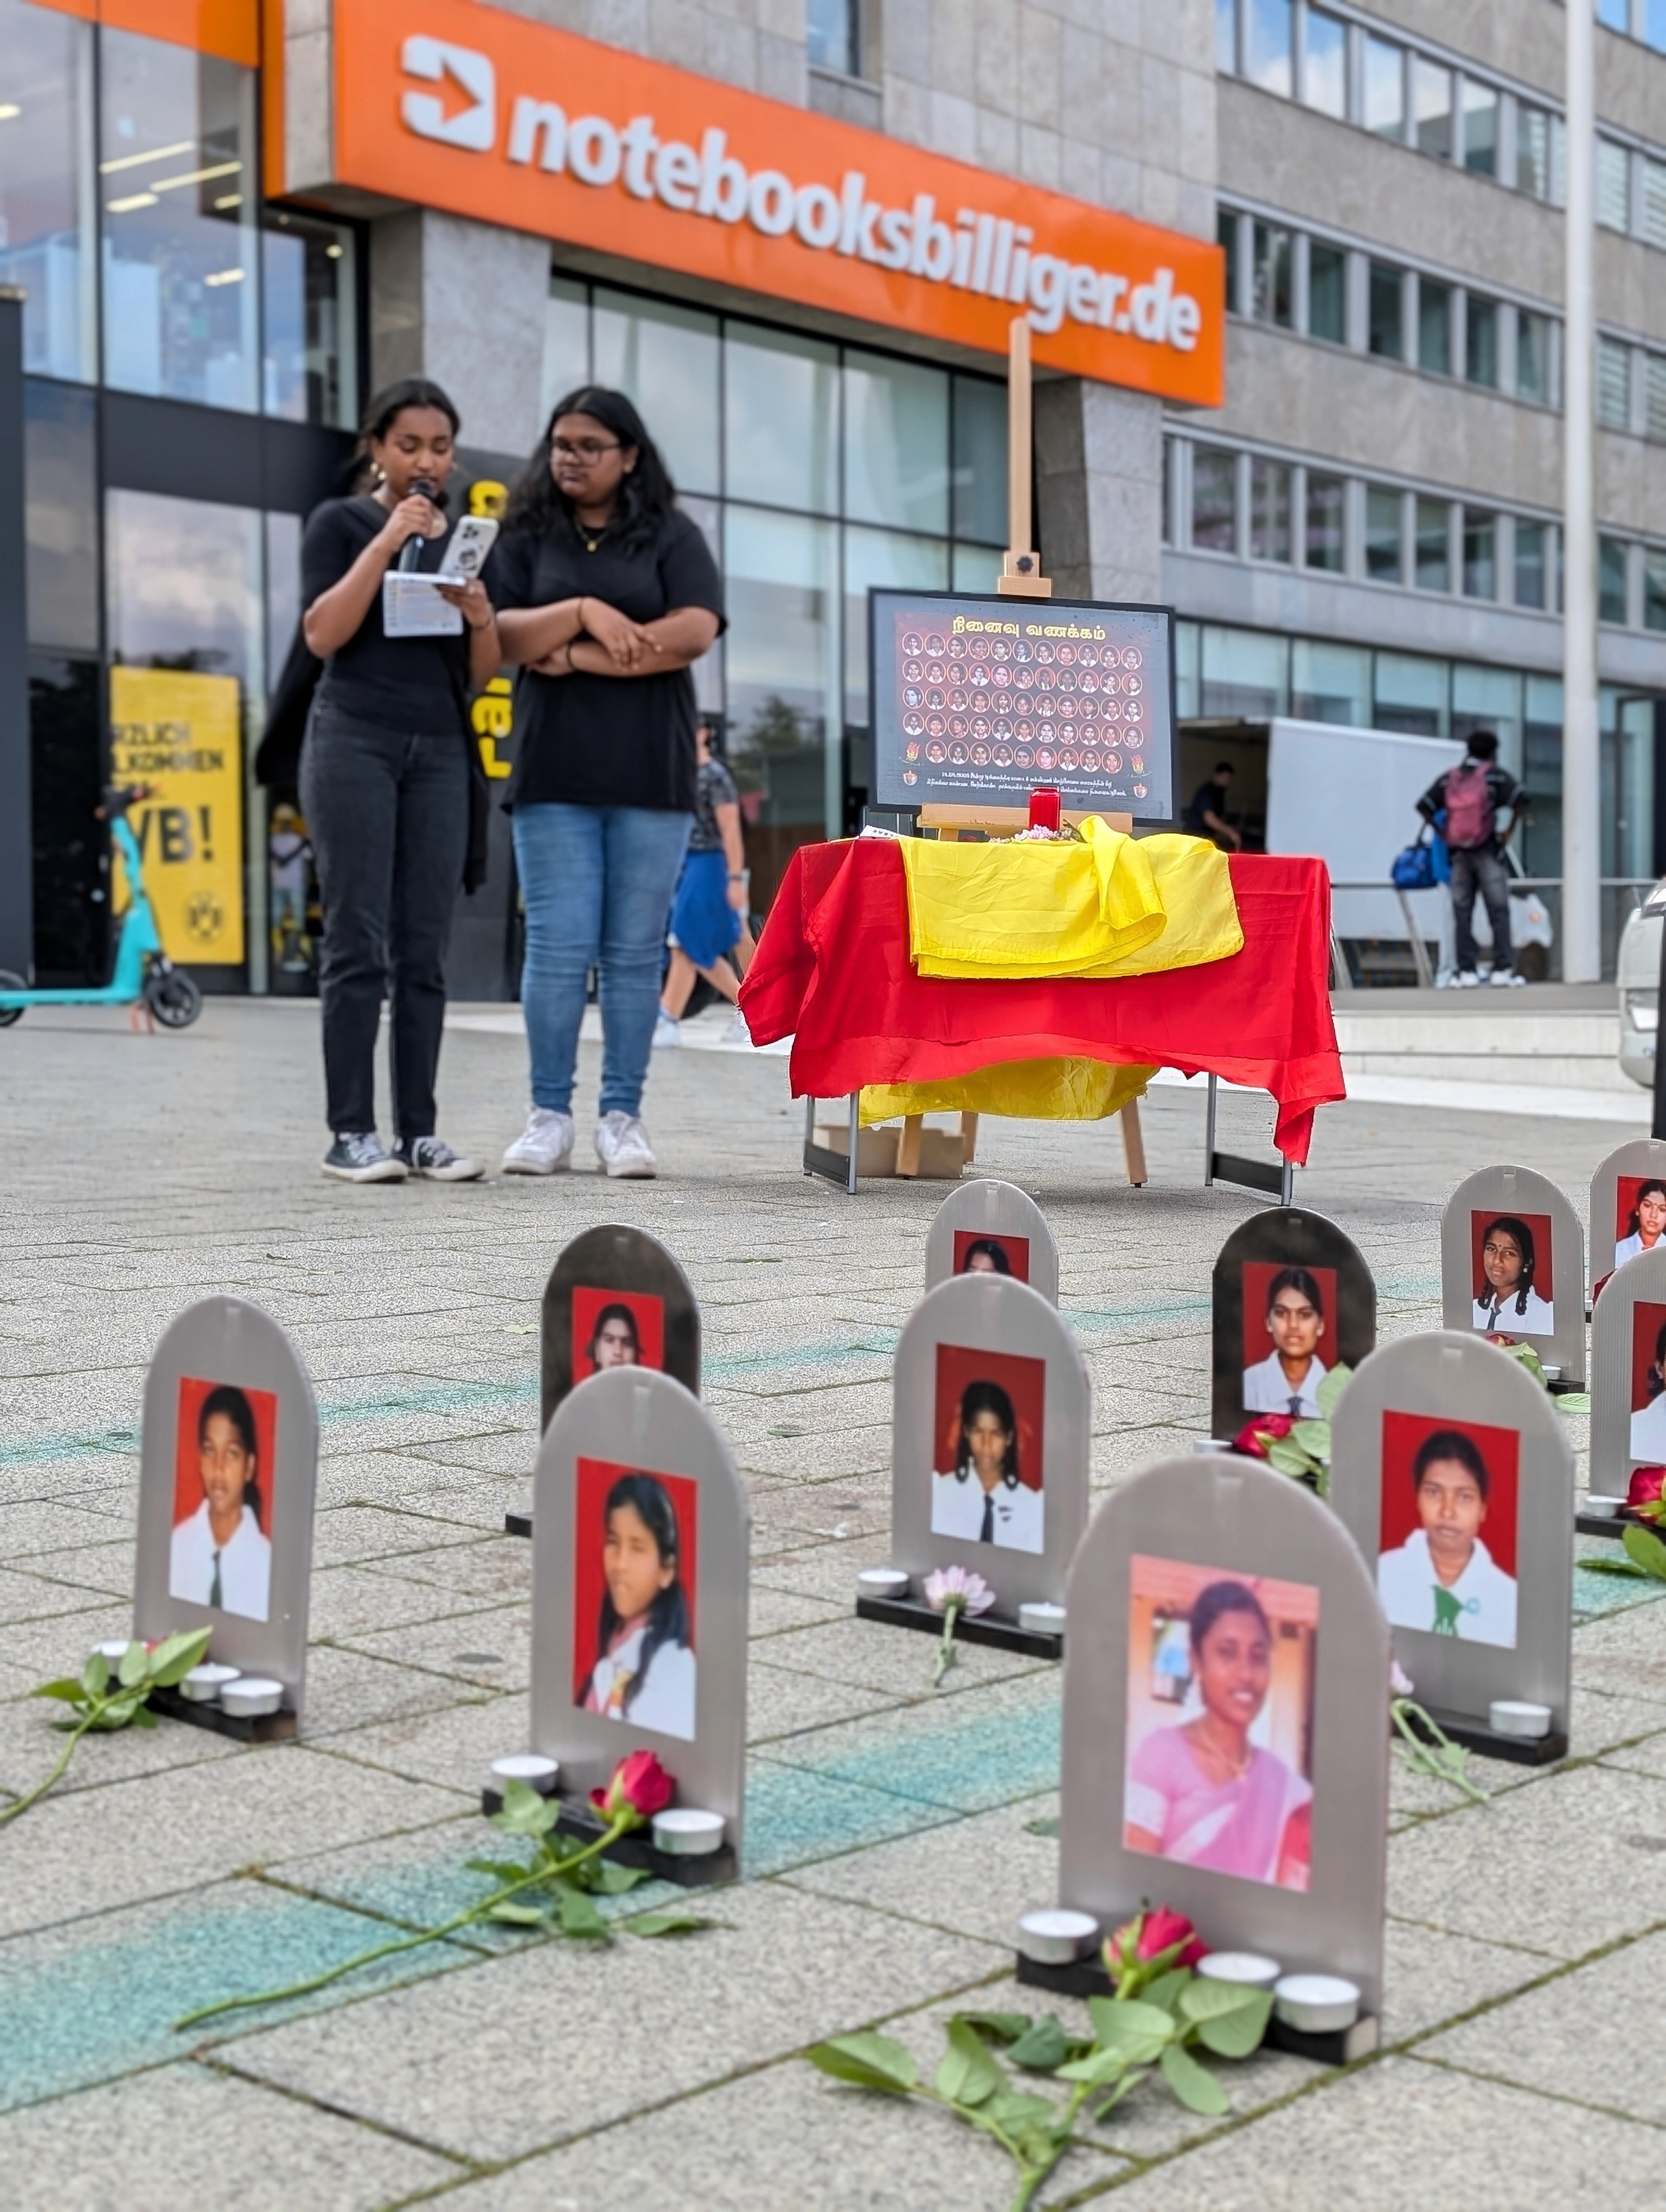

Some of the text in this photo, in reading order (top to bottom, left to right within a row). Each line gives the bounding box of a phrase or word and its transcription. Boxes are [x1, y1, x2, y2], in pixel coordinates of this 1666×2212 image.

[509, 98, 1200, 351] notebooksbilliger.de
[952, 615, 1106, 640] நினைவு வணக்கம்
